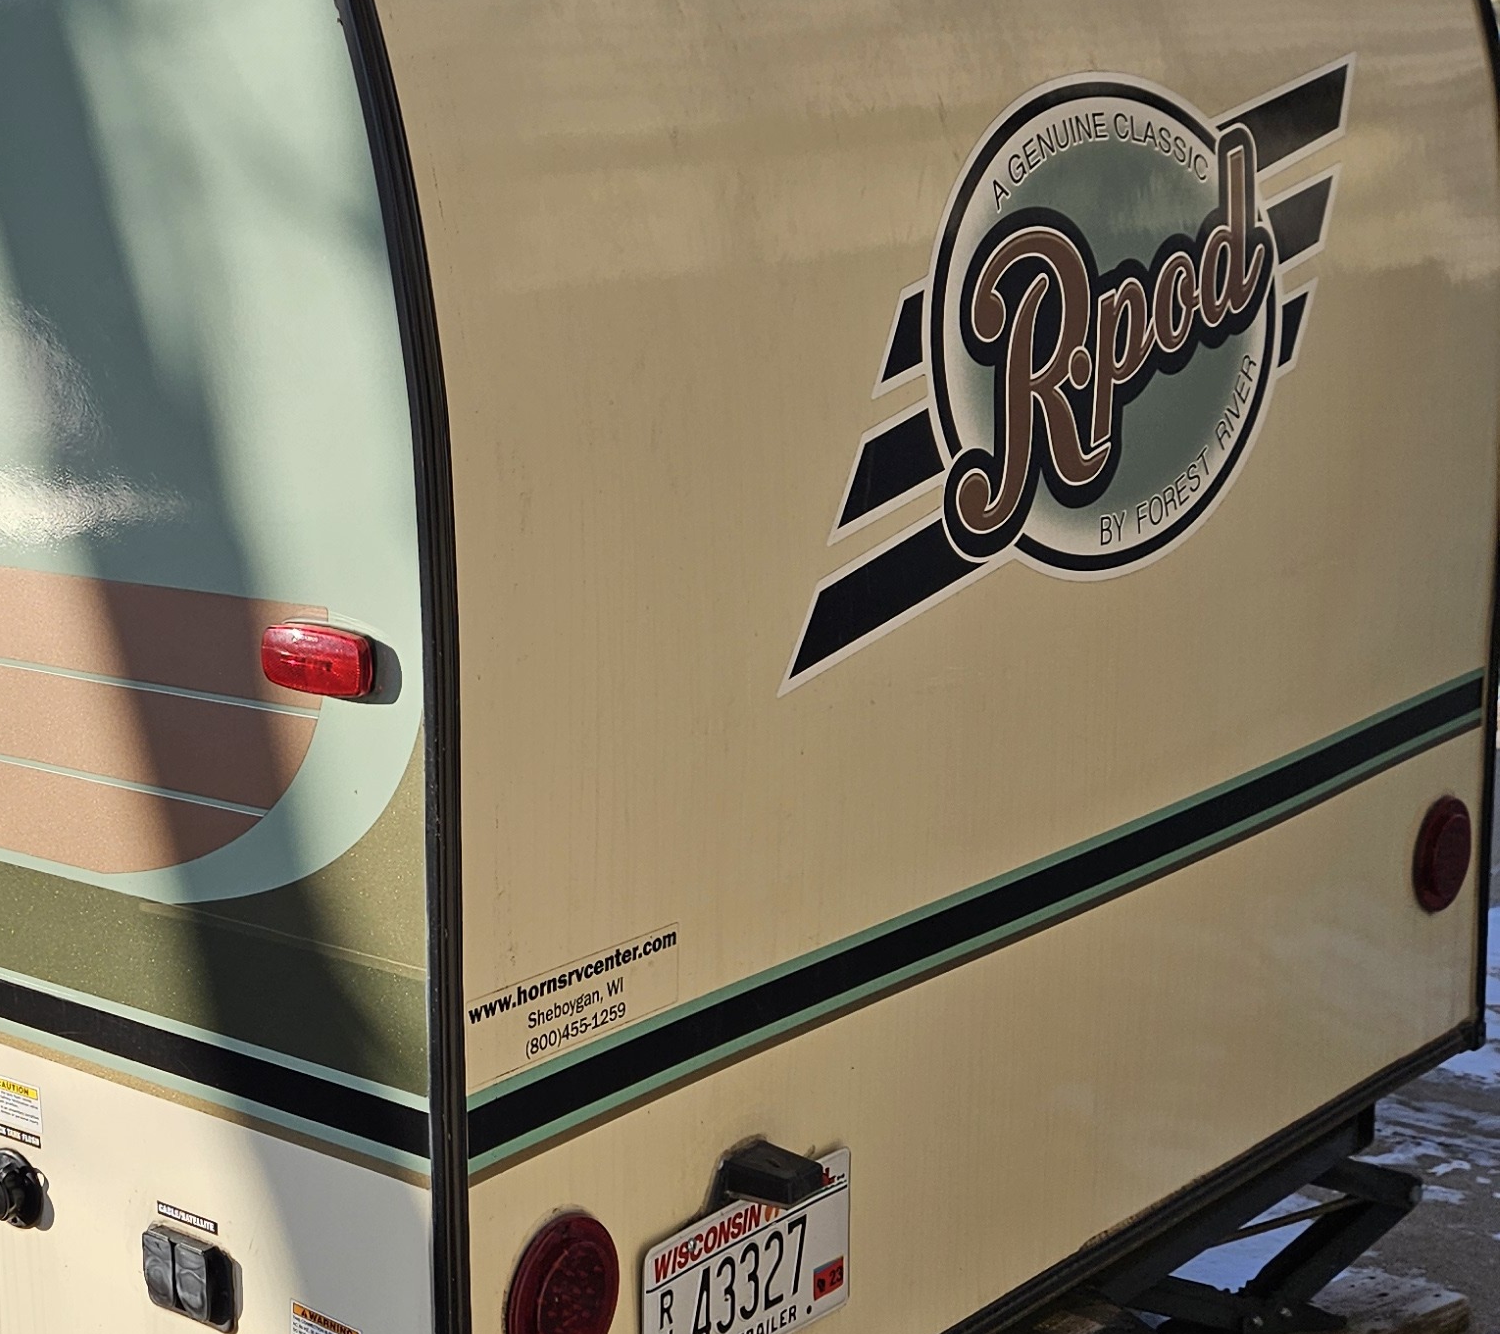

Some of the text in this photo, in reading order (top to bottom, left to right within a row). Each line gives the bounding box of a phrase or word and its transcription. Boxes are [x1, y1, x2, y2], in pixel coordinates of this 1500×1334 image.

[992, 112, 1209, 211] A GENUINE CLASSIC
[1100, 354, 1257, 546] BY FOREST RIVER
[468, 931, 677, 1024] www.hornsrvcenter.com
[528, 976, 624, 1029] Sheboygan, WI
[526, 1002, 626, 1059] (800)455-1259
[654, 1204, 762, 1284] WISCONSIN
[830, 1266, 843, 1285] 23
